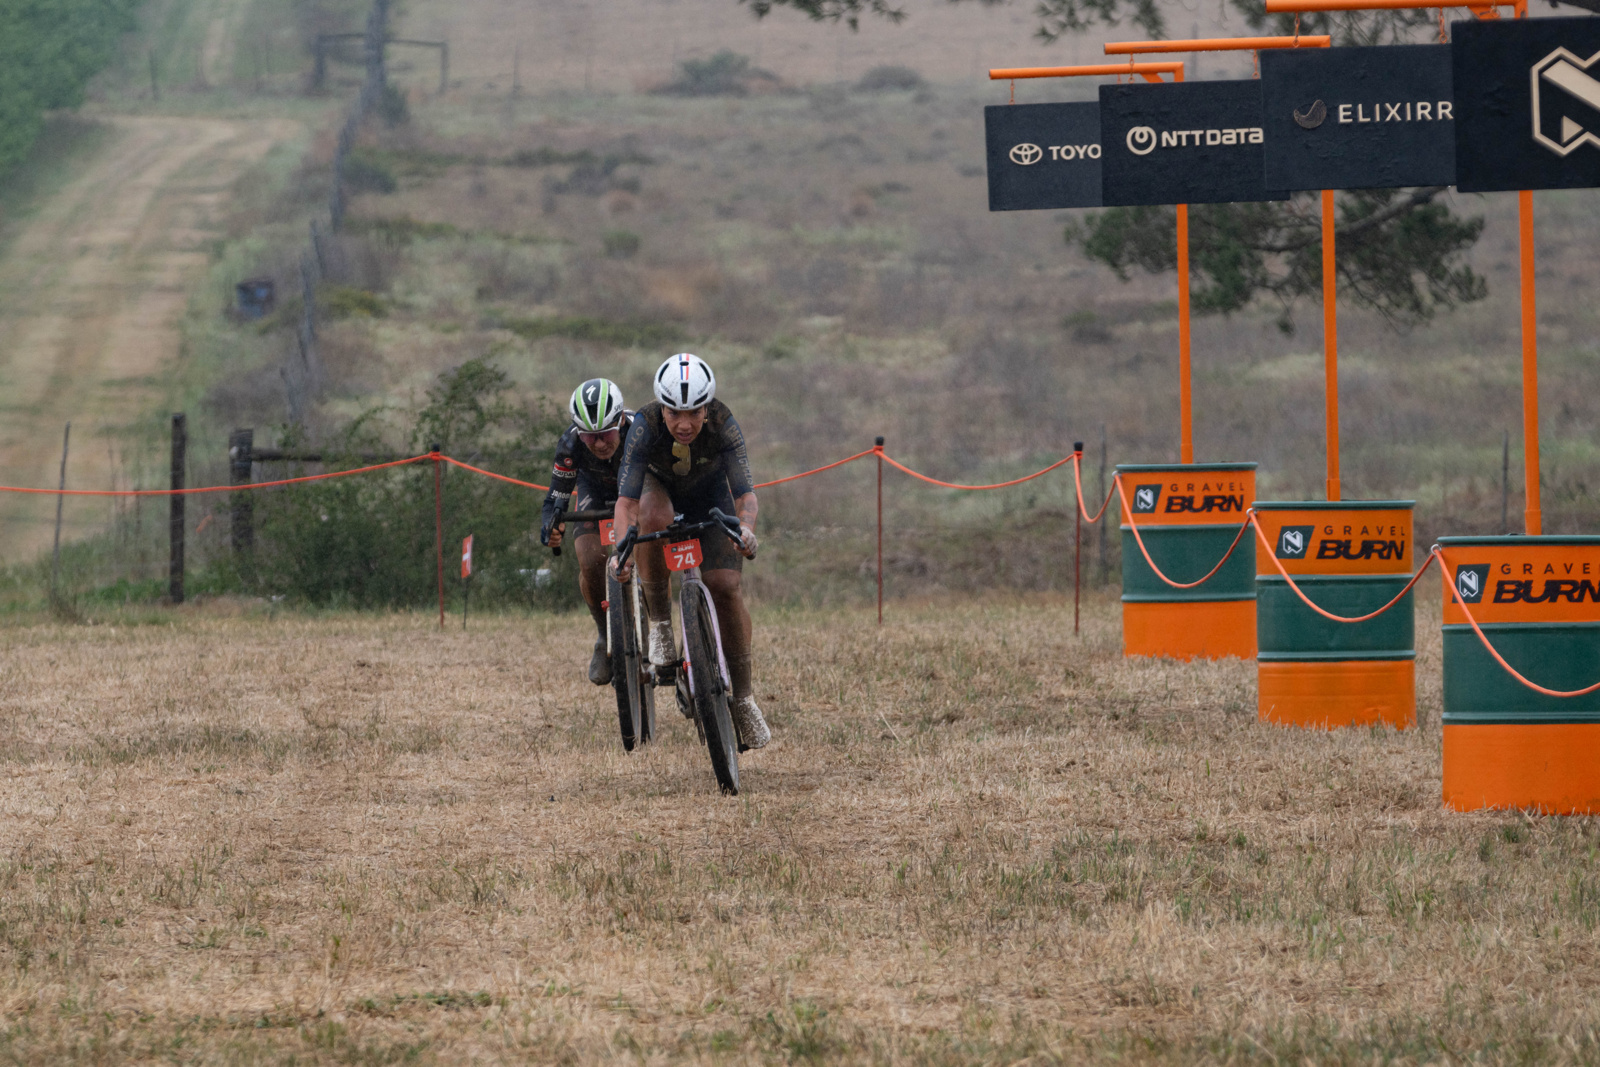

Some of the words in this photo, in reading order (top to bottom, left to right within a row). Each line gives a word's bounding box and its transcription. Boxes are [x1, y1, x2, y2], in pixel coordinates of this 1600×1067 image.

[1338, 101, 1454, 123] ELIXIRR
[1161, 130, 1204, 147] NTT
[1048, 144, 1101, 160] TOYO
[1170, 482, 1244, 493] GRAVEL
[1164, 495, 1244, 514] BURN
[1324, 525, 1405, 536] GRAVEL
[1316, 540, 1405, 560] BURN
[674, 552, 696, 568] 74
[1501, 563, 1600, 574] GRAVE
[1492, 579, 1600, 604] BURN
